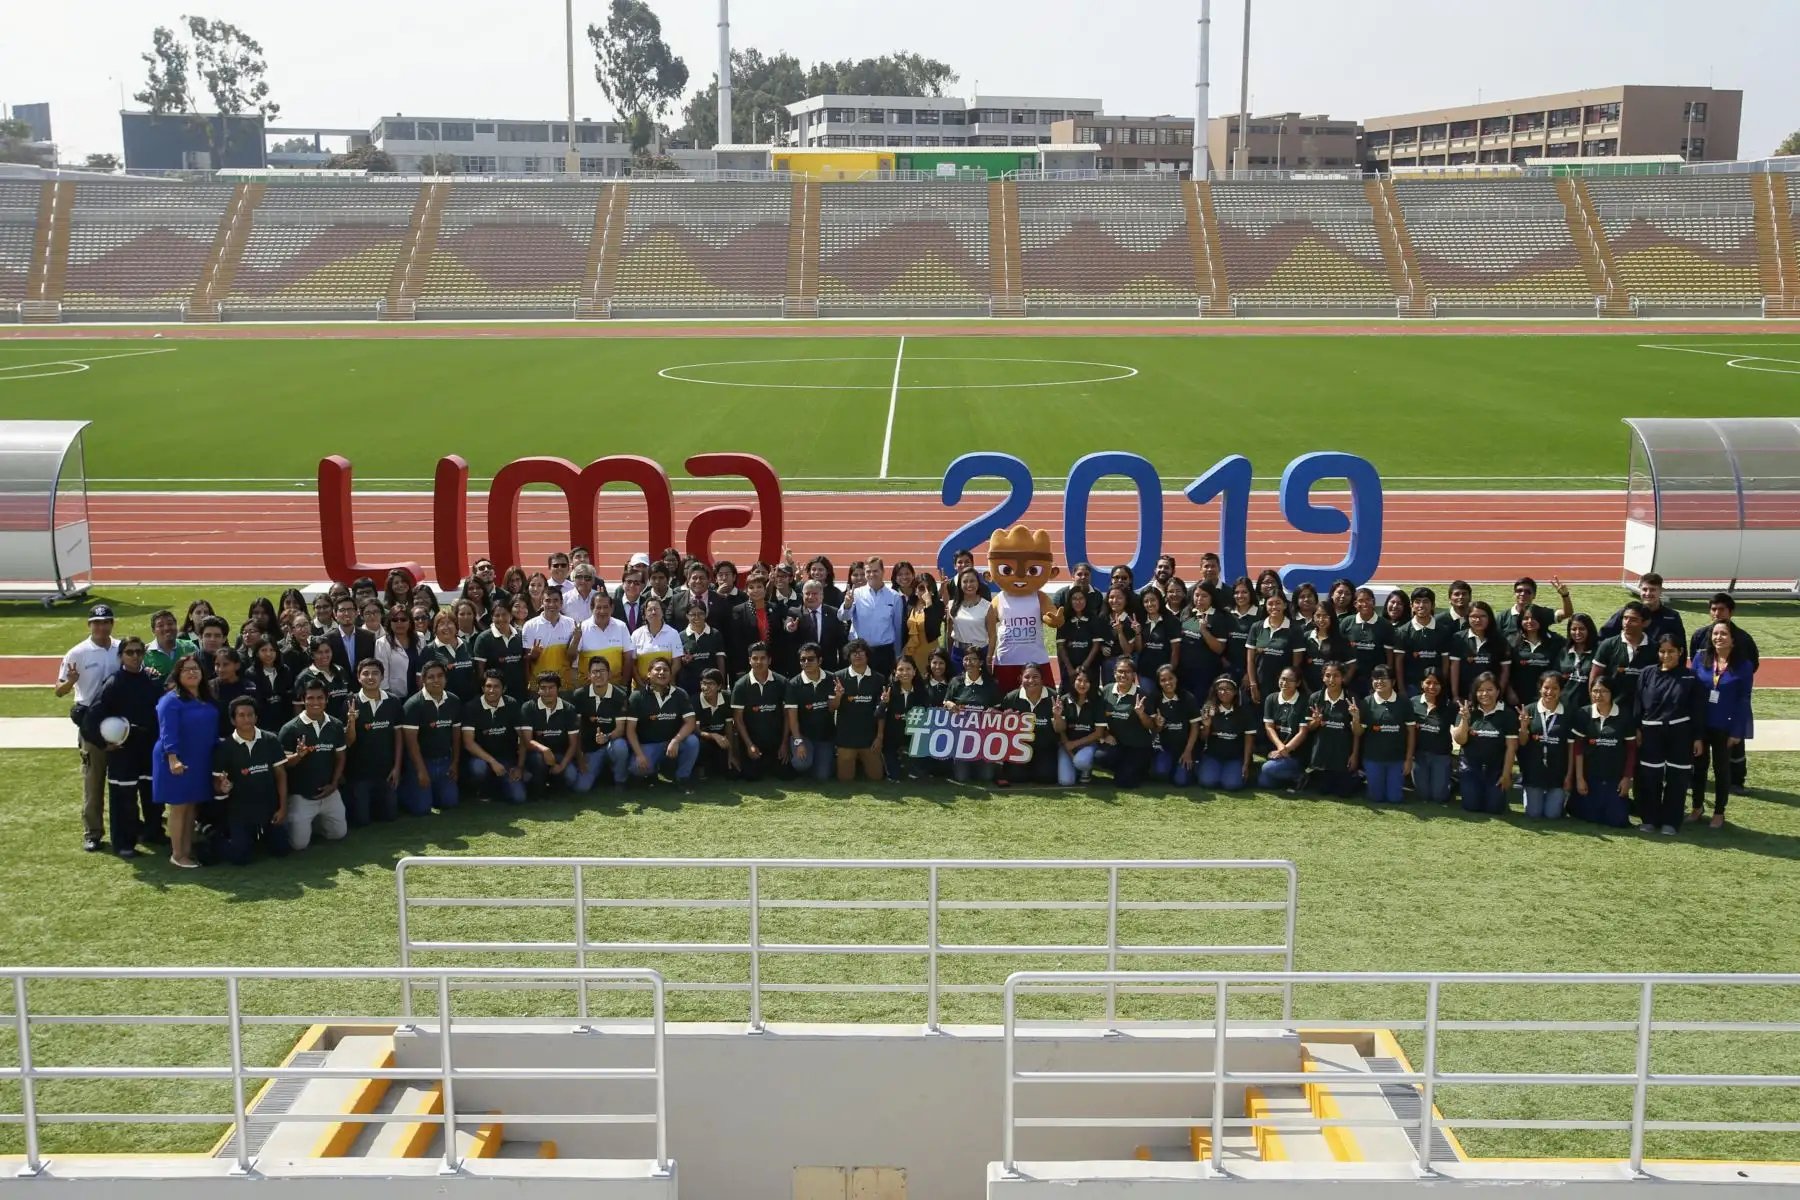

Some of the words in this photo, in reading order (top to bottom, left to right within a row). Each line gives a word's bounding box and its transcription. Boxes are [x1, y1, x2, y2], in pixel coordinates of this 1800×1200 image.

[937, 451, 1384, 593] 2019
[1005, 627, 1037, 638] 2019
[907, 708, 1036, 732] #JUGAMOS
[906, 727, 1034, 763] TODOS
